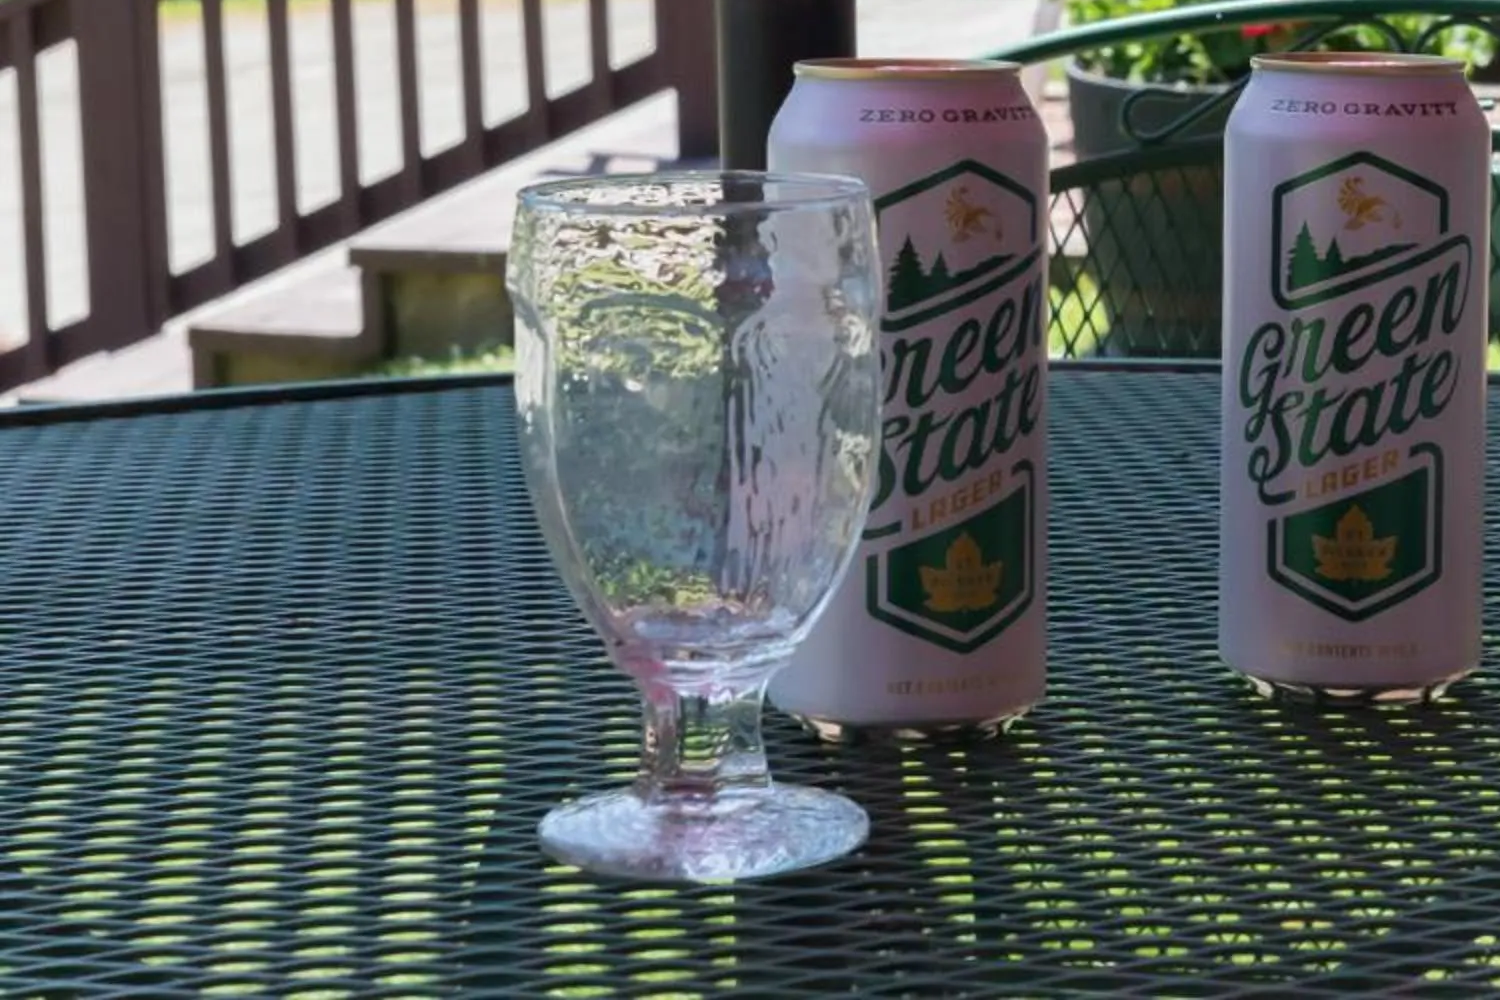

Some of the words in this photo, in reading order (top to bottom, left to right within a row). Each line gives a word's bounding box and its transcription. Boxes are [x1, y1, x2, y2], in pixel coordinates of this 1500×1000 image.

[859, 108, 935, 123] ZERO
[1270, 99, 1337, 115] ZERO
[880, 273, 1043, 408] reen
[1239, 261, 1462, 443] Green
[1248, 350, 1461, 483] State
[912, 470, 1003, 530] LAGER
[1305, 450, 1399, 498] LAGER
